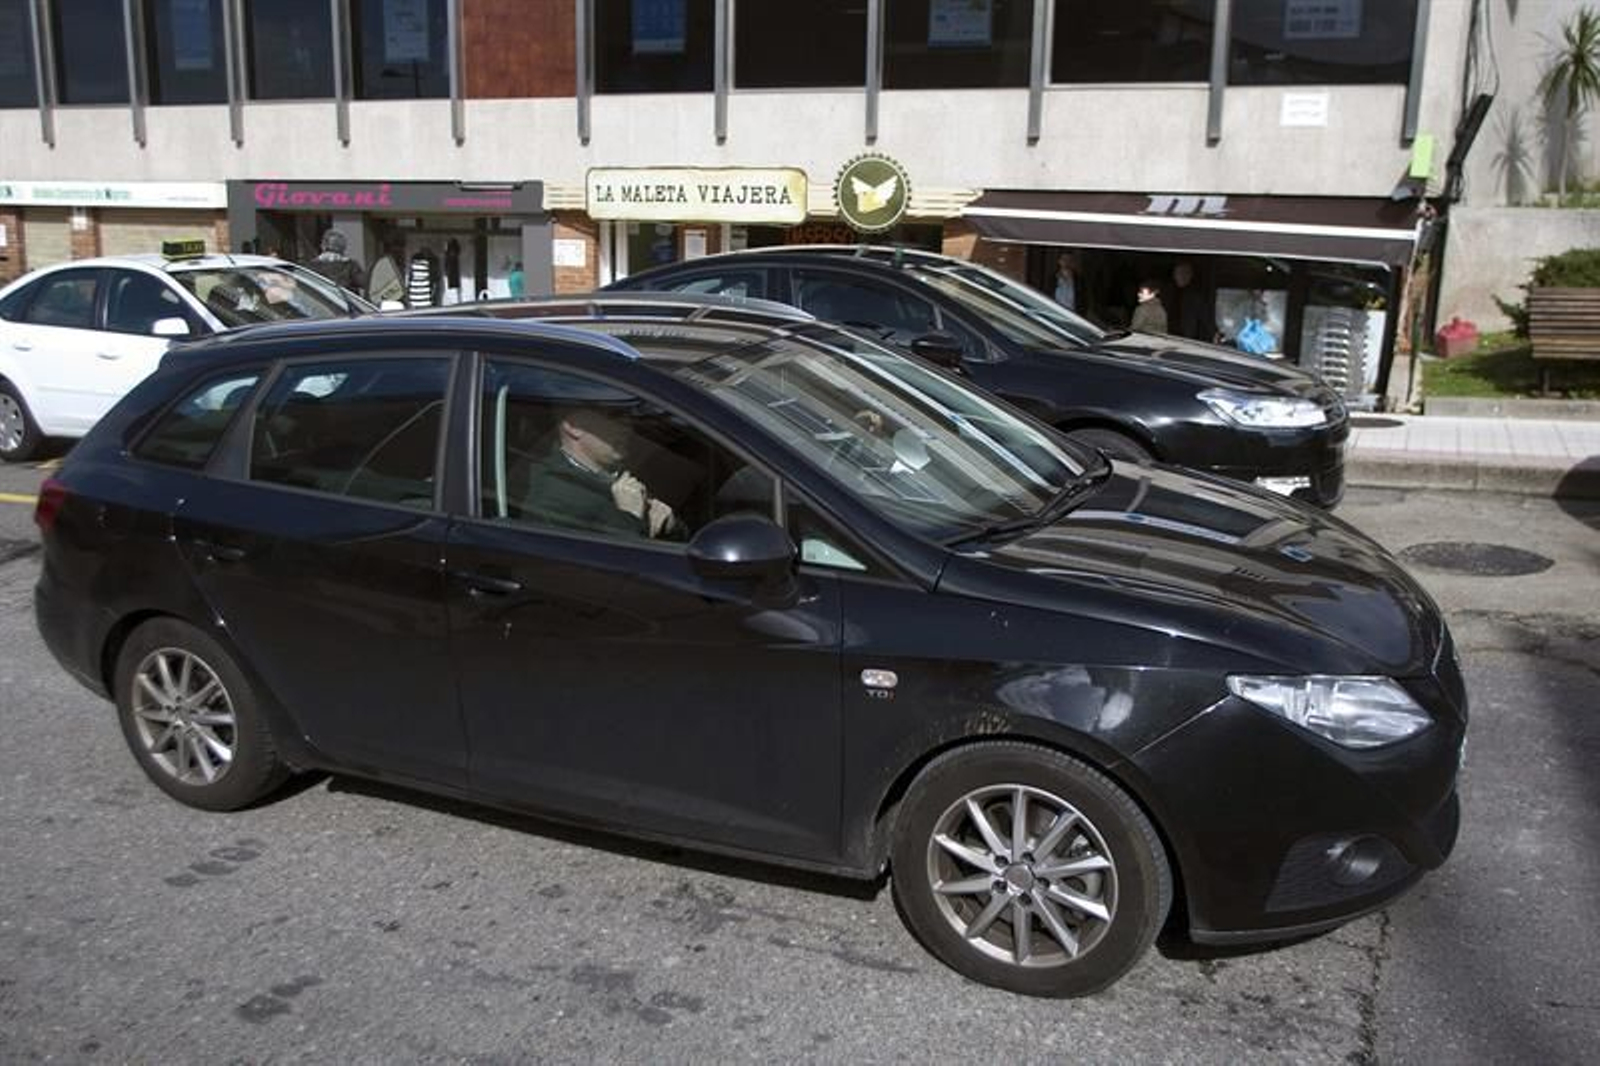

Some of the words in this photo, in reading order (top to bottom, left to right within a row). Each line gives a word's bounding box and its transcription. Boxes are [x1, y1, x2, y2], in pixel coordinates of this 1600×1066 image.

[254, 182, 392, 207] Giovani
[595, 185, 614, 202] LA
[621, 185, 687, 203] MALETA
[697, 185, 792, 204] VIAJERA
